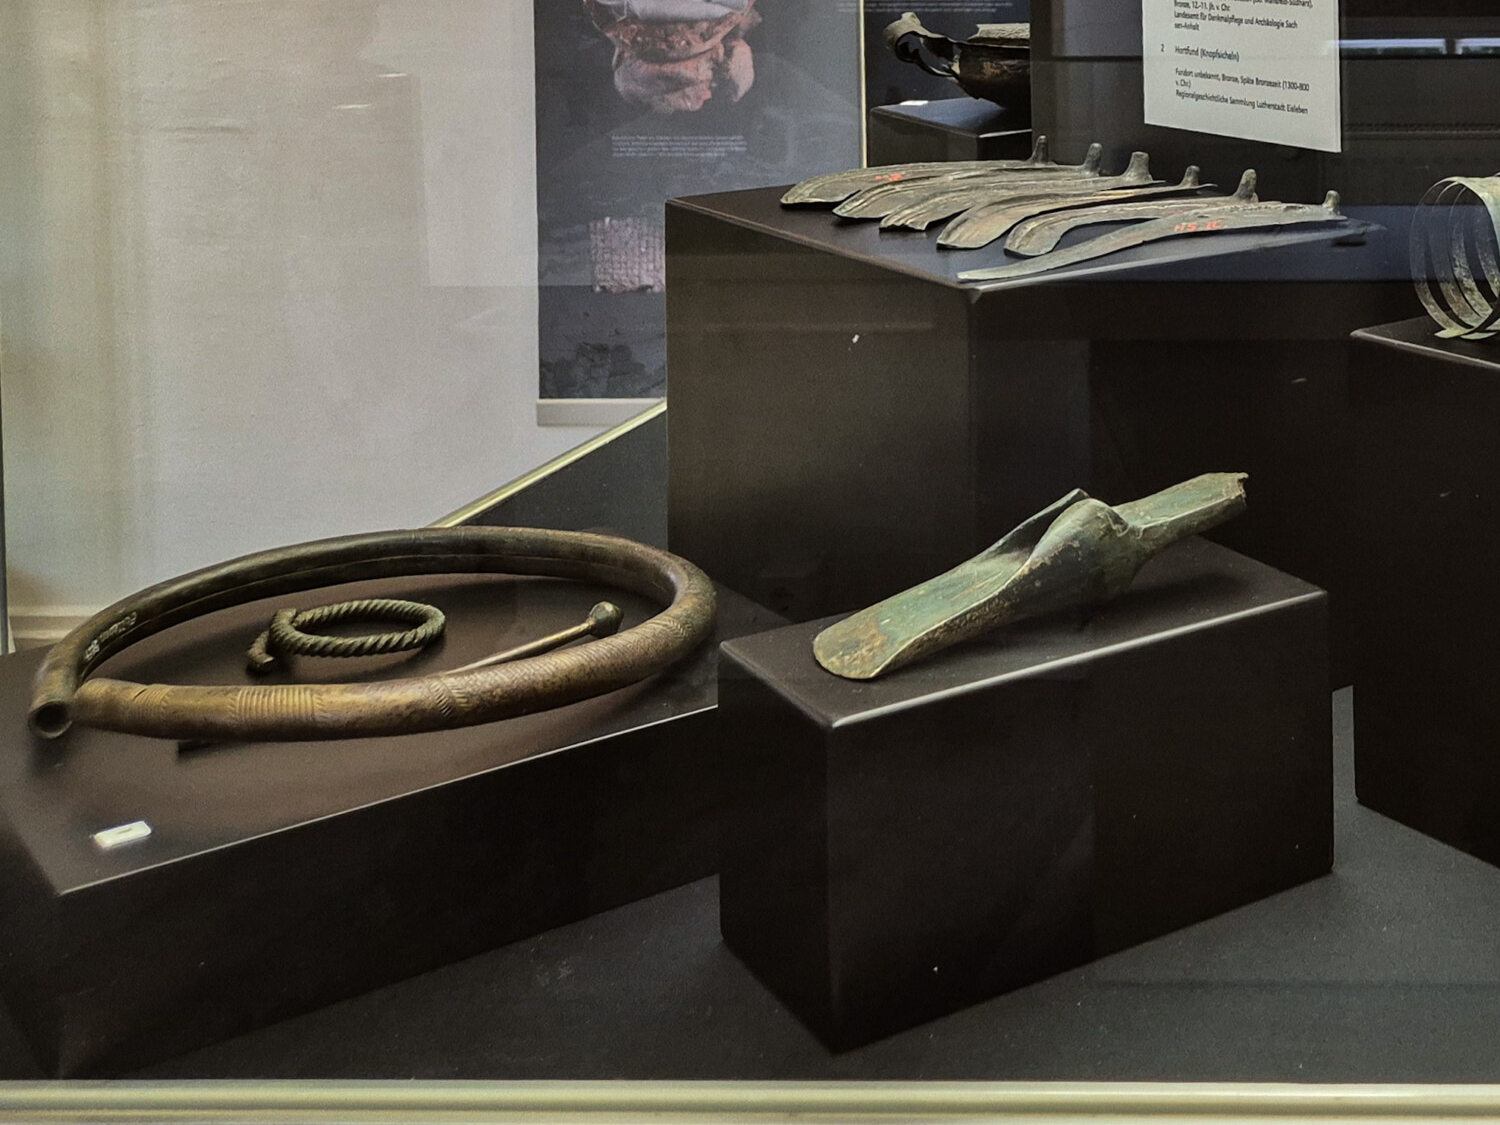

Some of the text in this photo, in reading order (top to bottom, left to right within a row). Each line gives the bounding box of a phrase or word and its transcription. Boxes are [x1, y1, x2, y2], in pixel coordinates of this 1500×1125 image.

[1160, 43, 1240, 62] 2 Hortfund (Knopfsicheln)
